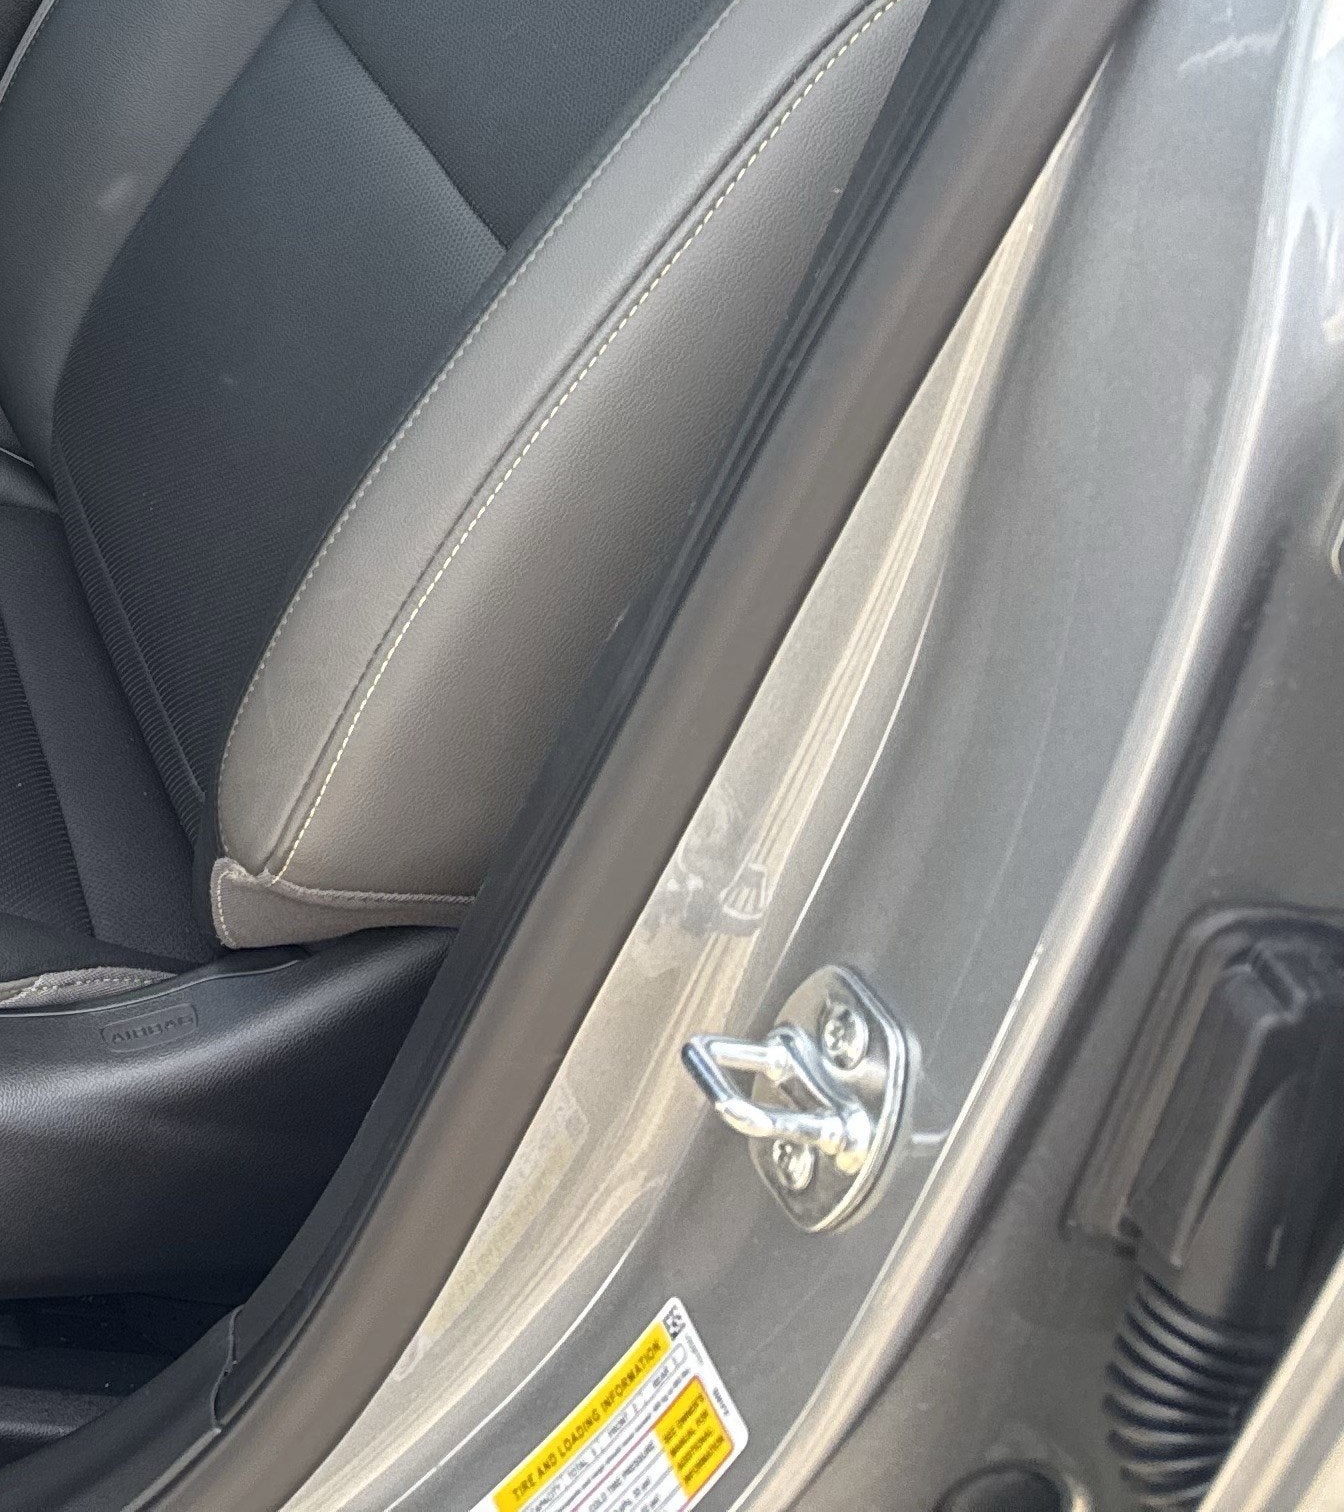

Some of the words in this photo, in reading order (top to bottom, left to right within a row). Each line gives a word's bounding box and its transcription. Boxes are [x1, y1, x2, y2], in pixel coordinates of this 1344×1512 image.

[512, 1473, 536, 1501] TIRE
[537, 1453, 558, 1480] AND
[557, 1408, 601, 1458] LOADING
[600, 1340, 662, 1413] INFORMATION
